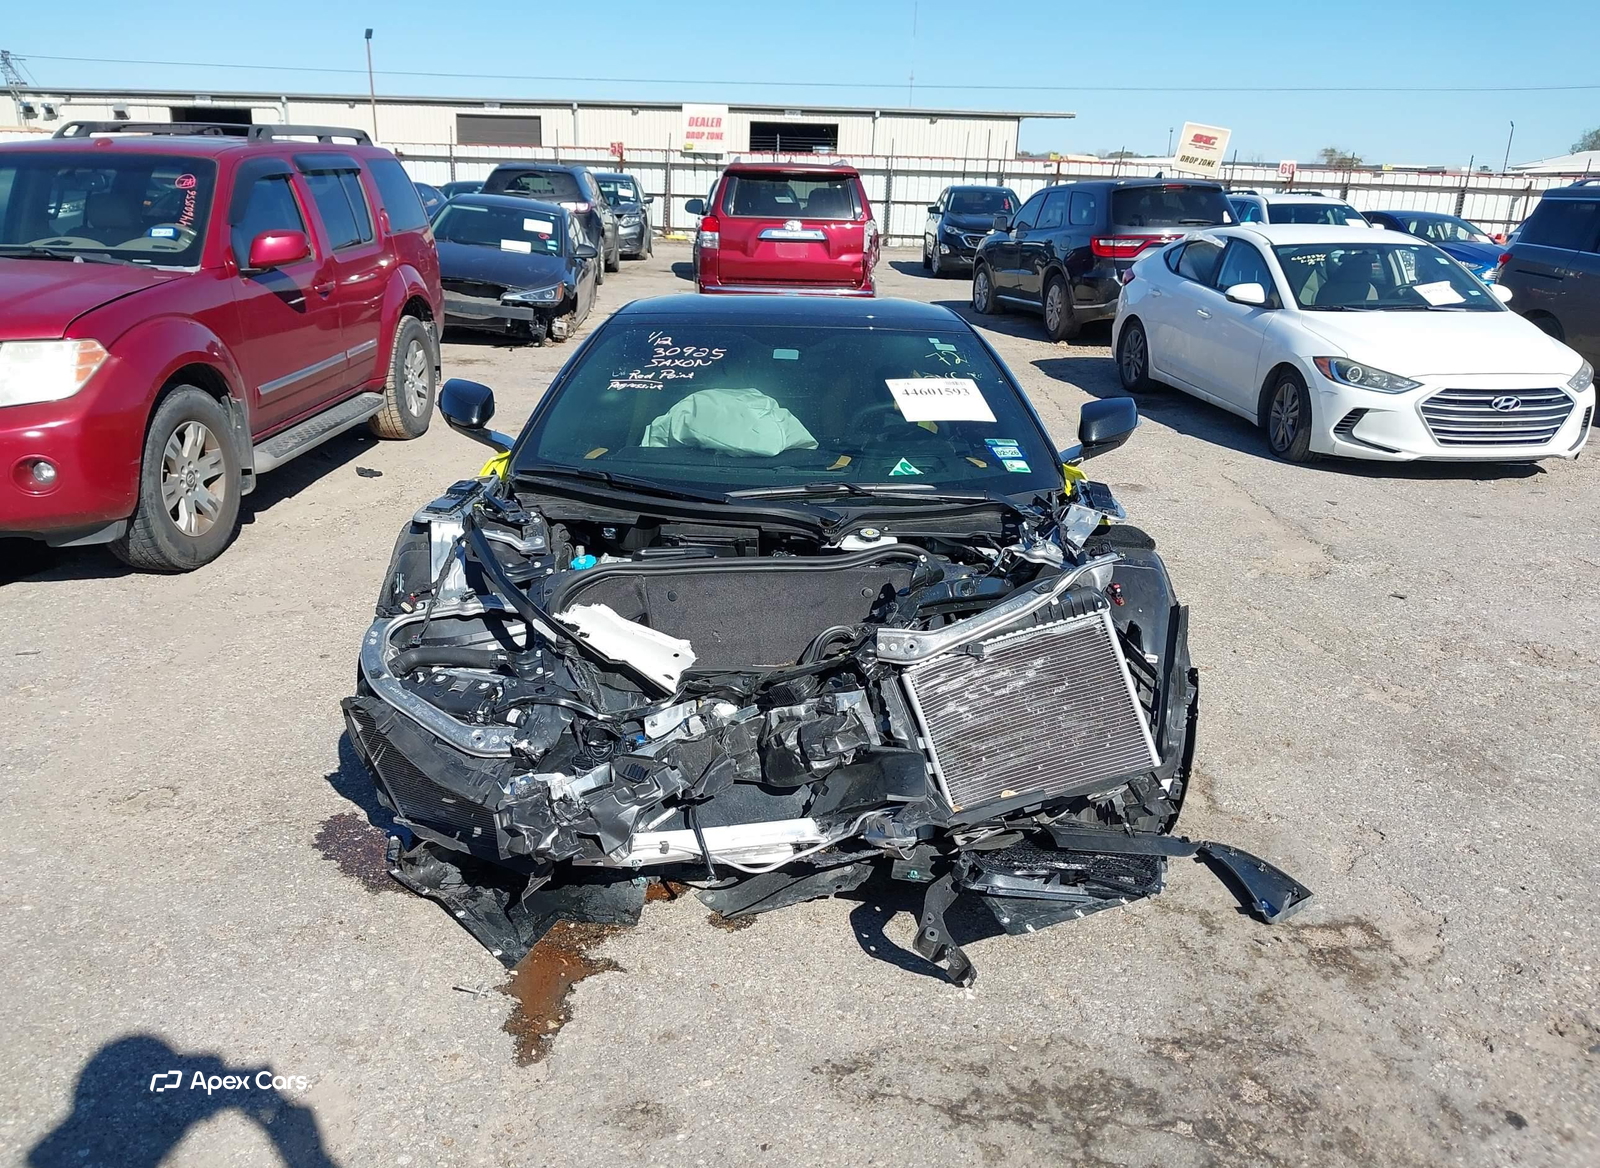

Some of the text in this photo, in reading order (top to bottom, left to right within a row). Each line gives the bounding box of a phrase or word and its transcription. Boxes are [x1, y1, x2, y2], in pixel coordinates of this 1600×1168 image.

[688, 116, 722, 128] DEALER
[686, 131, 724, 140] DROP ZONE
[1180, 154, 1216, 168] DROP ZONE
[1281, 163, 1295, 174] 60
[652, 346, 727, 359] 30925
[644, 358, 712, 367] SAXON
[901, 387, 970, 397] 44601593
